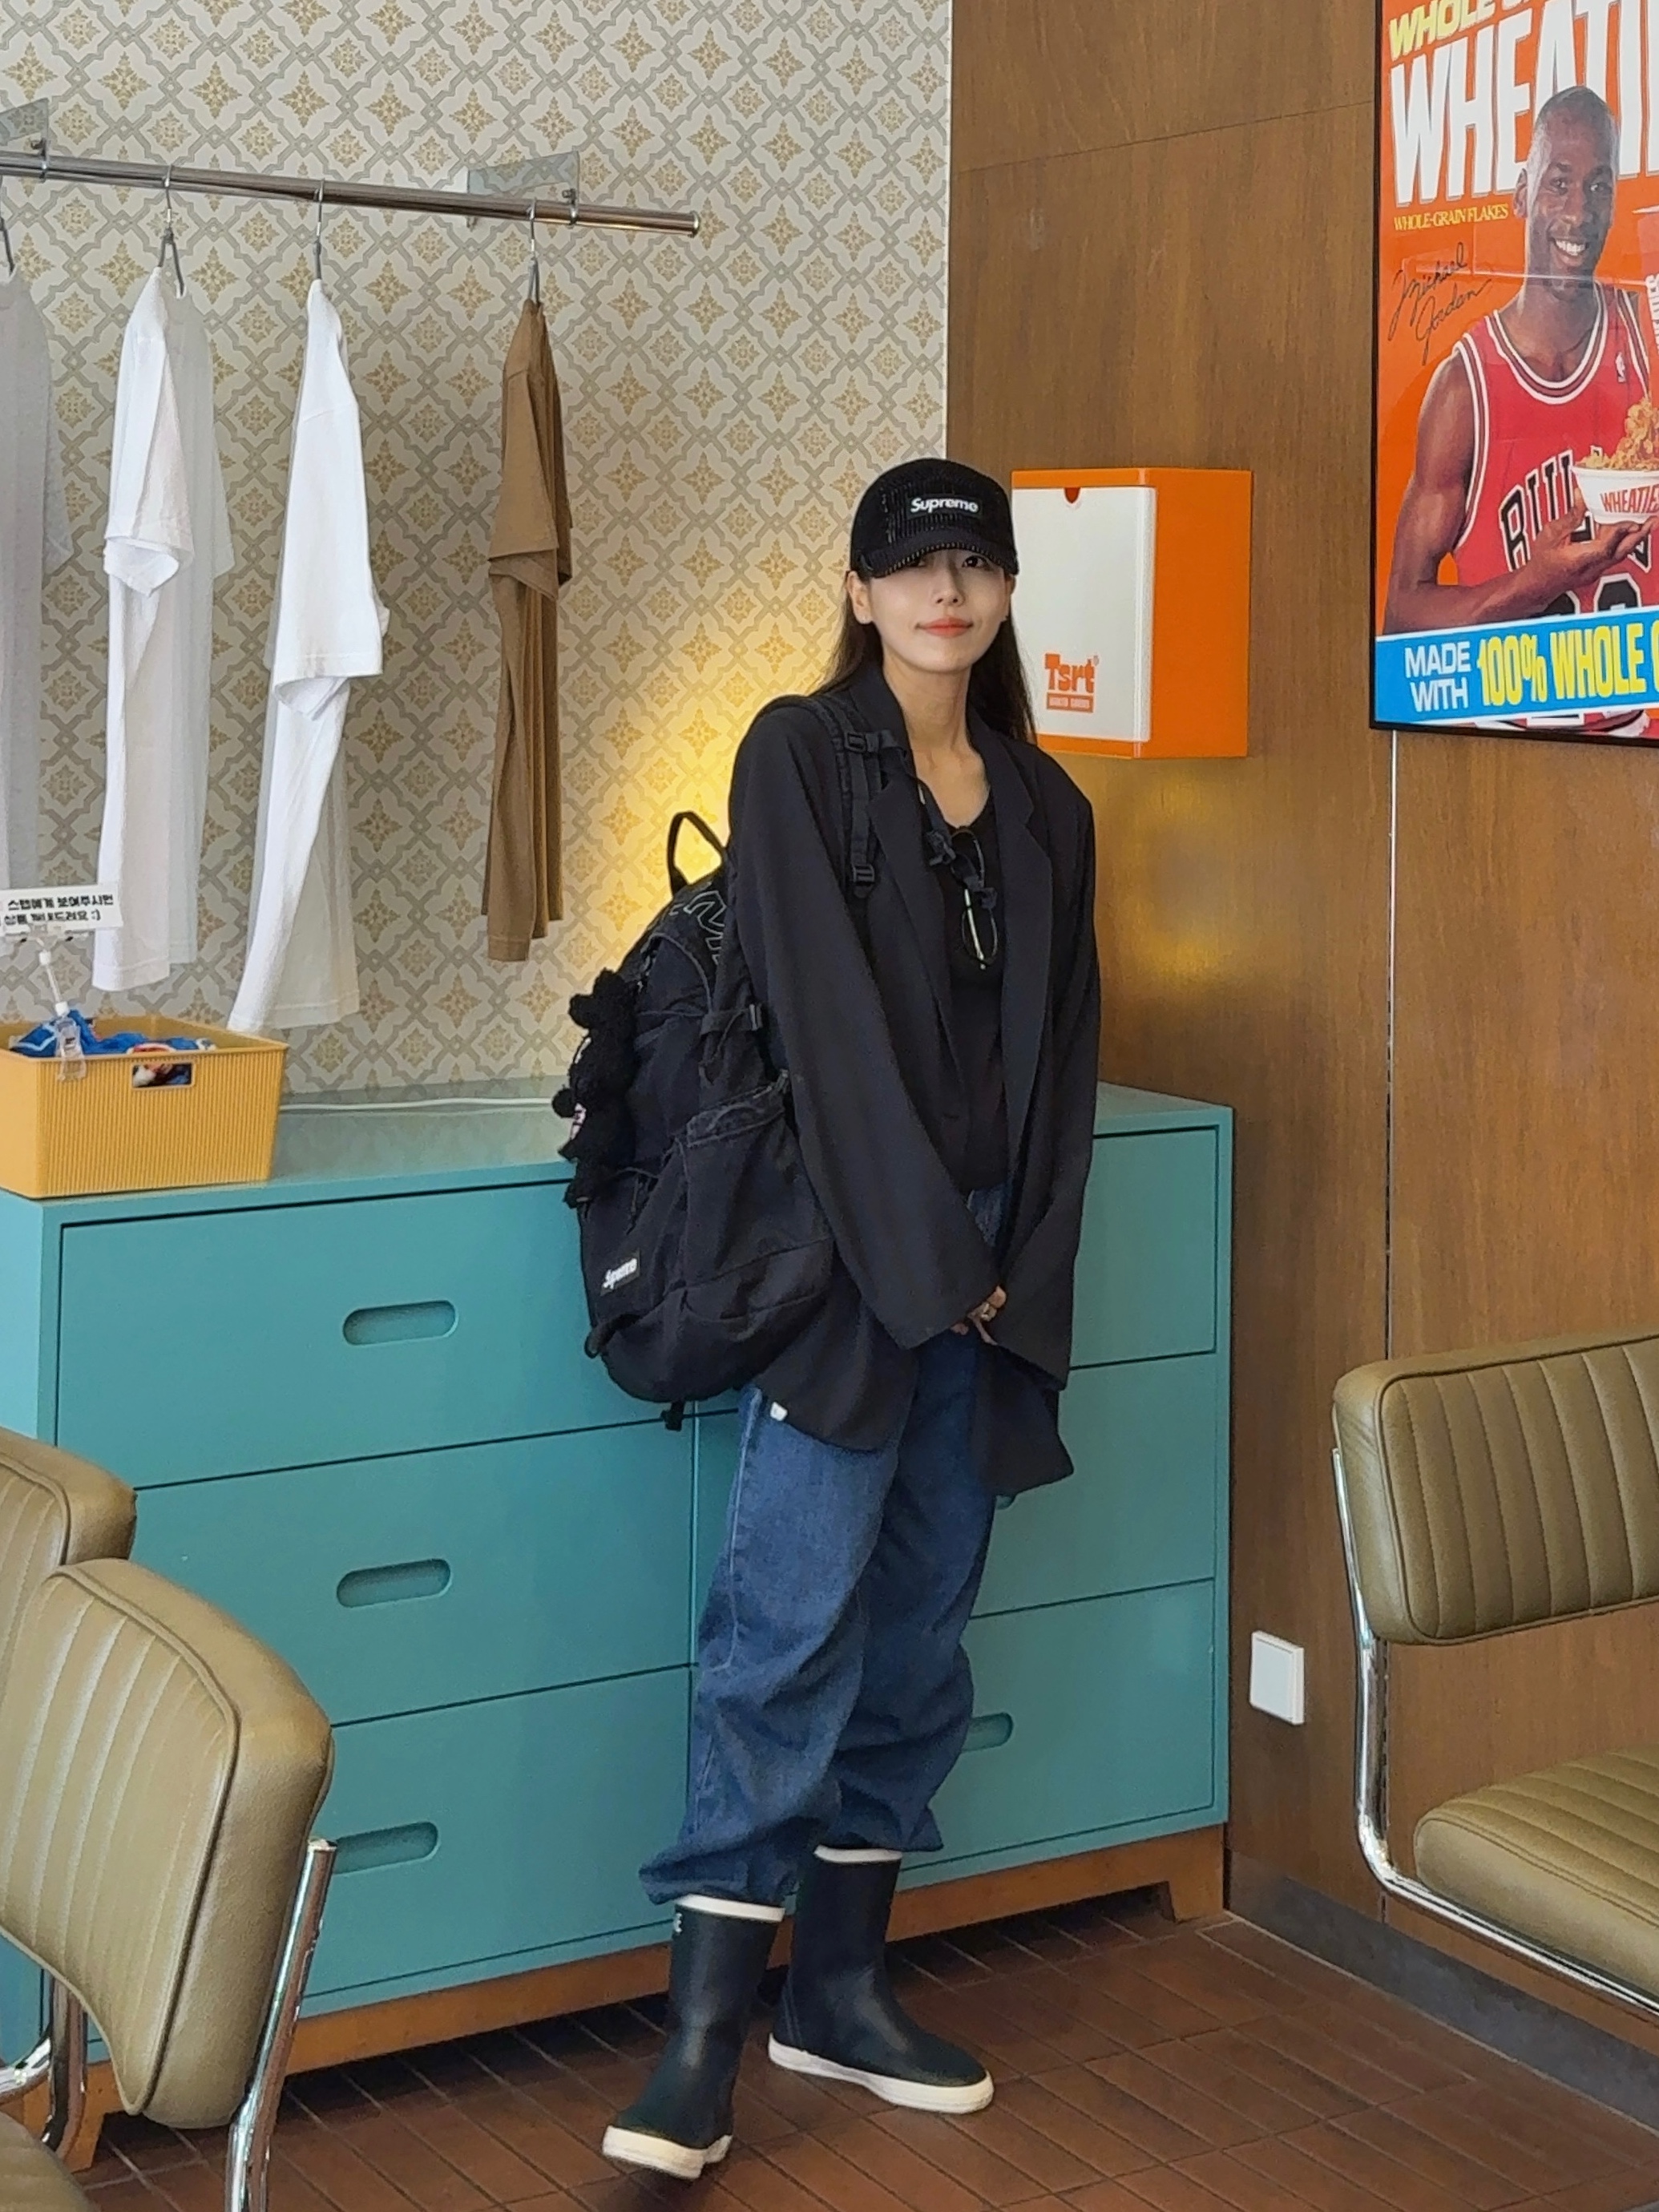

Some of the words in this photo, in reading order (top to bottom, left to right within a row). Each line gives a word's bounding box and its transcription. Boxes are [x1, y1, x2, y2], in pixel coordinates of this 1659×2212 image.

[1391, 0, 1659, 208] WHEATI
[1467, 204, 1509, 223] FLAKES
[910, 497, 979, 514] Supreme
[1404, 641, 1471, 678] MADE
[1477, 633, 1548, 706] 100%
[1549, 622, 1647, 700] WHOLE
[1410, 677, 1468, 712] WITH
